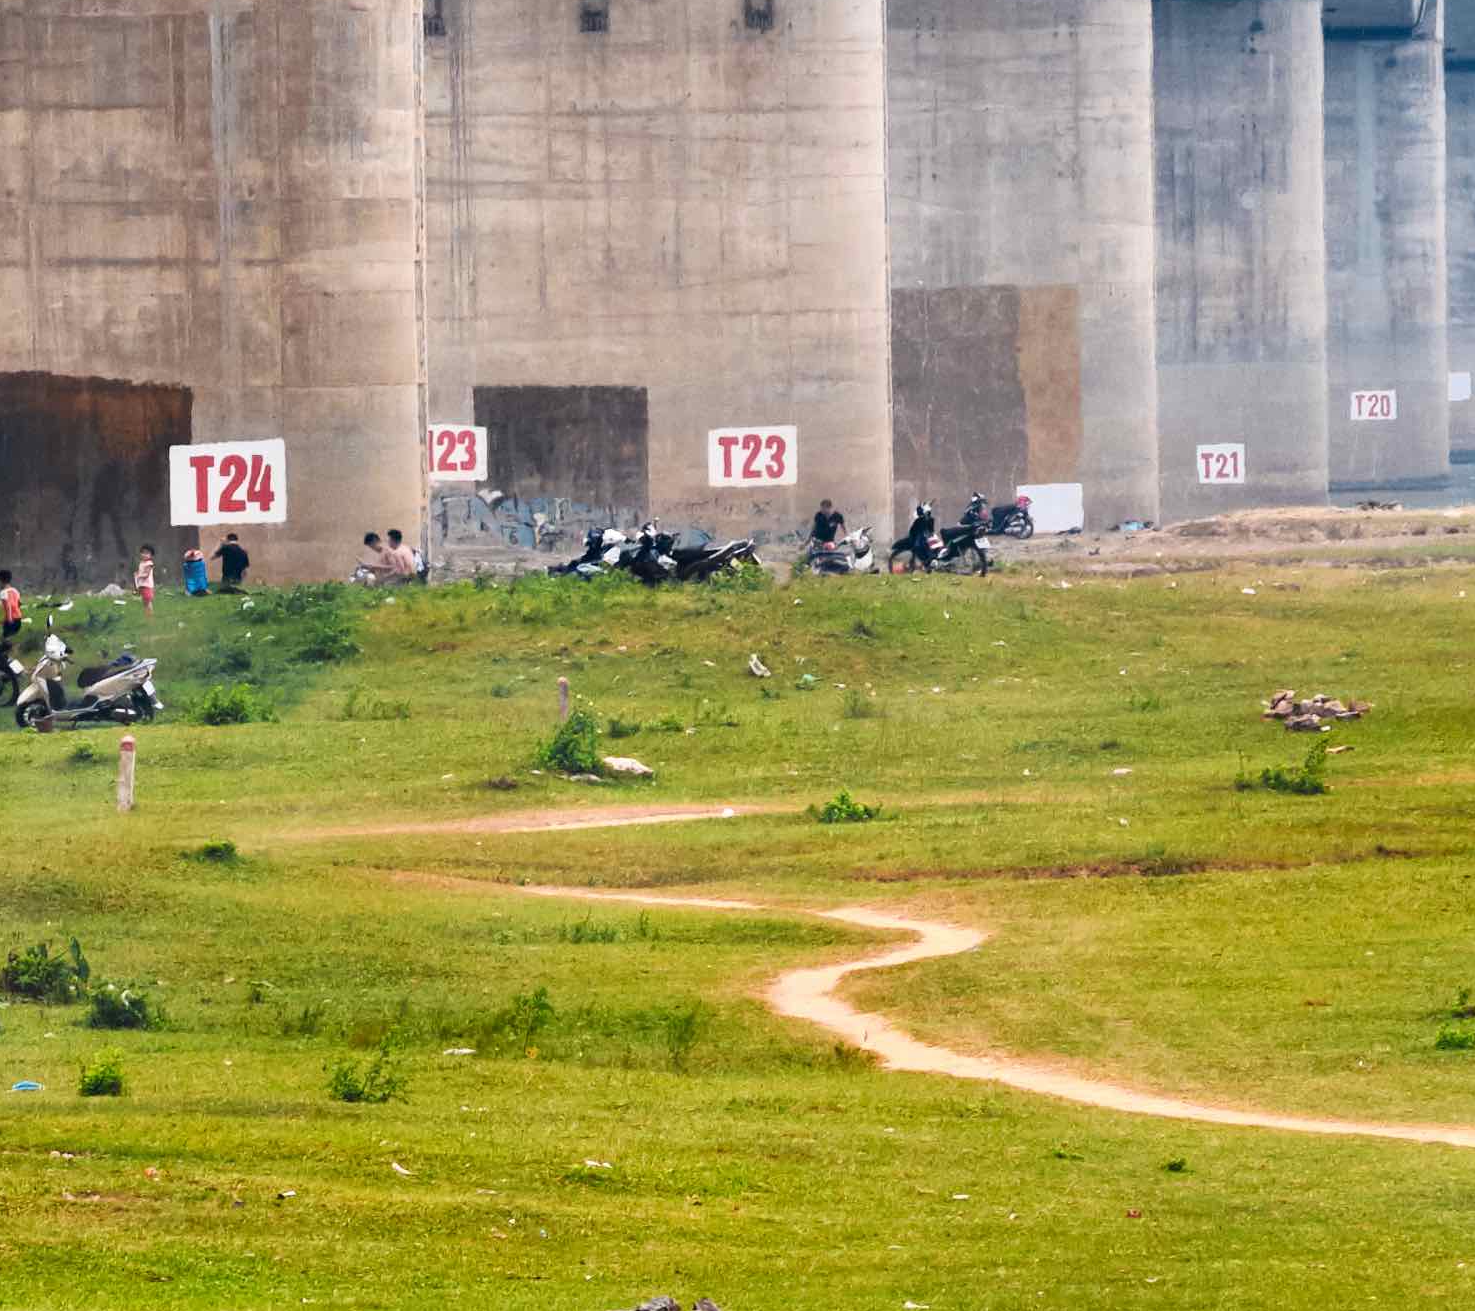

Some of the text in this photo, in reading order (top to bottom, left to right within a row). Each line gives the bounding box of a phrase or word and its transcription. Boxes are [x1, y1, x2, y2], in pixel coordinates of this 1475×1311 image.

[1355, 394, 1390, 418] T20
[717, 433, 787, 479] T23
[1200, 451, 1239, 479] T21
[188, 453, 275, 515] T24
